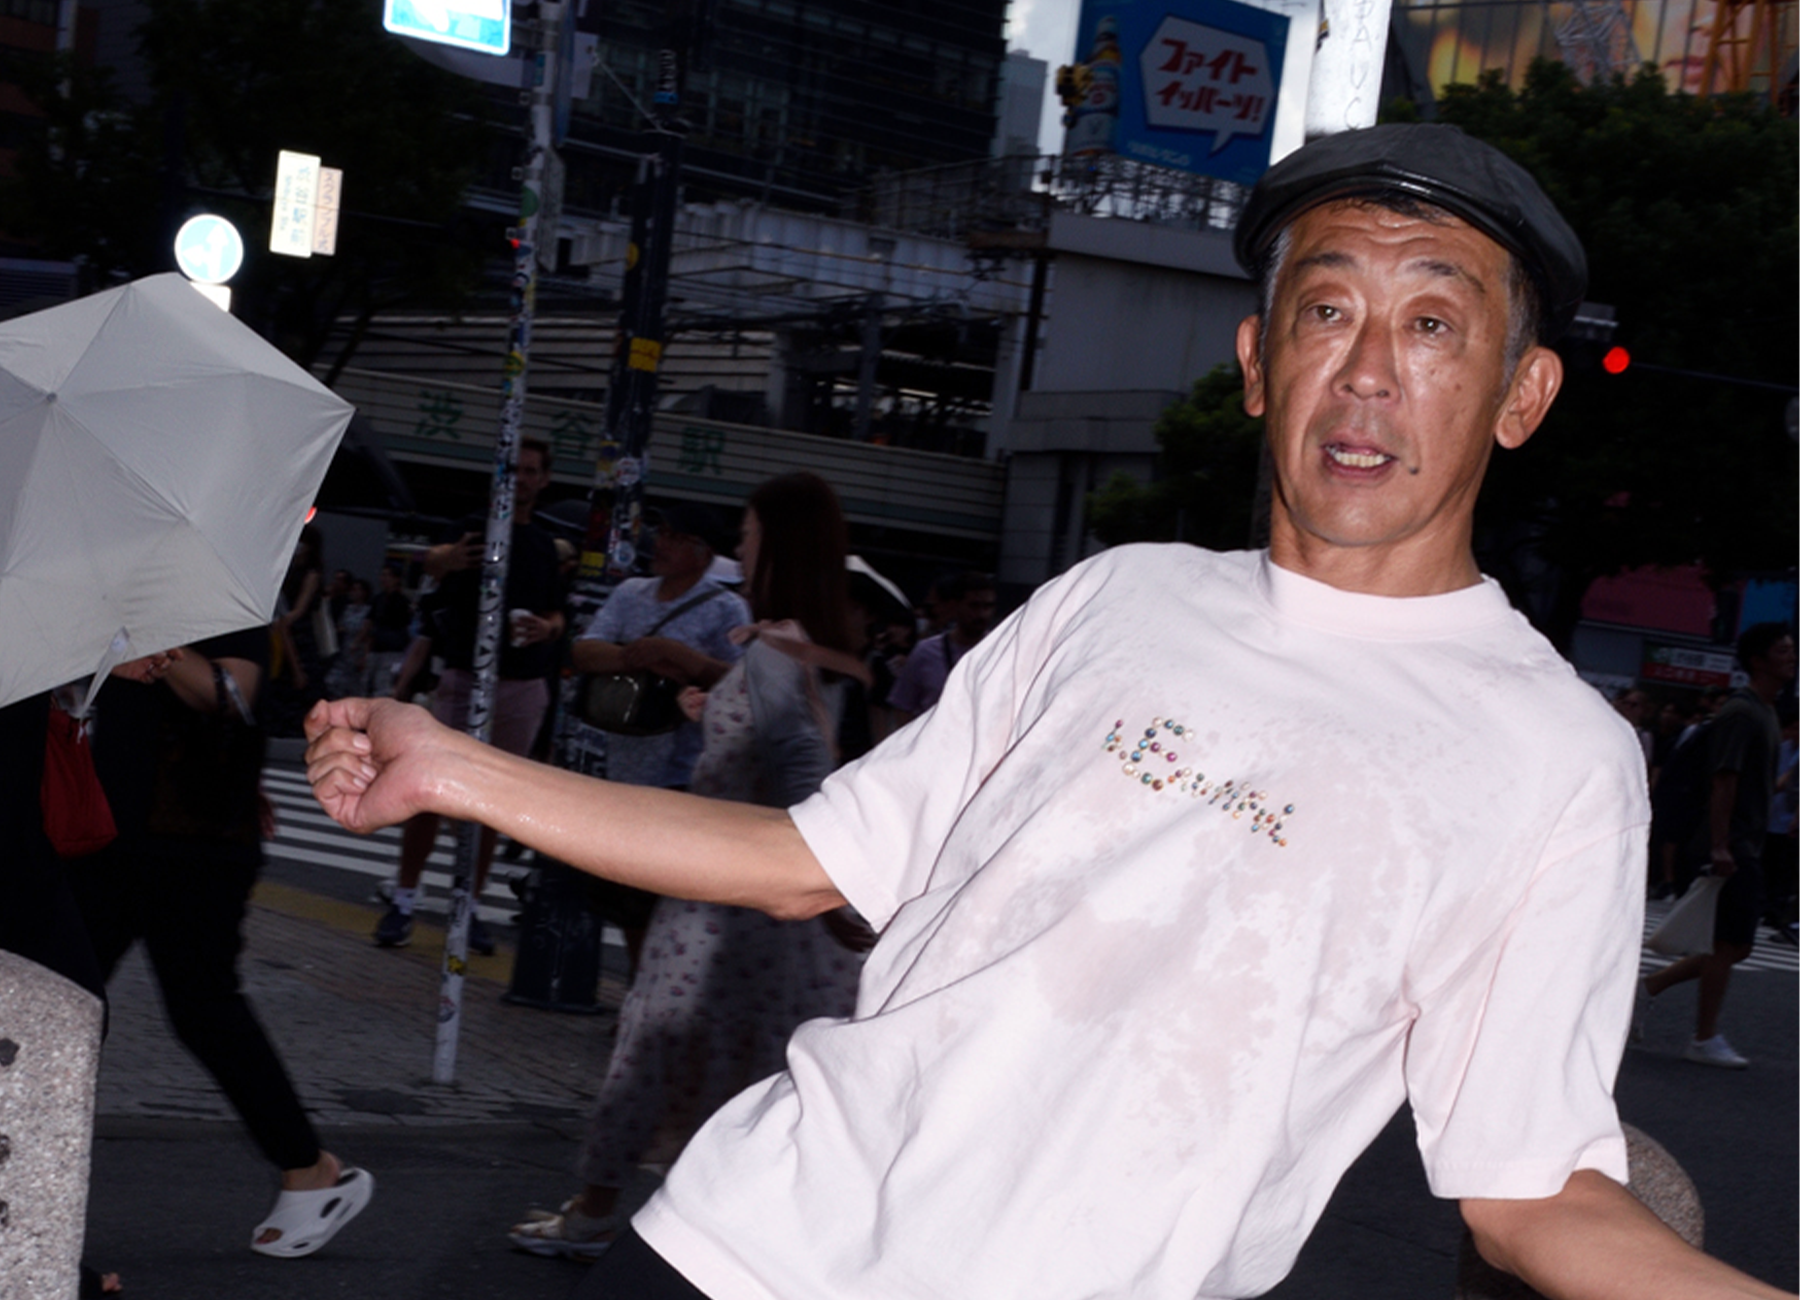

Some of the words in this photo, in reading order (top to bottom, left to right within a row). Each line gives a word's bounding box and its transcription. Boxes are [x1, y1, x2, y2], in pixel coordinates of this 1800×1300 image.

[1158, 37, 1259, 85] ファイト
[416, 390, 726, 474] 渋谷駅
